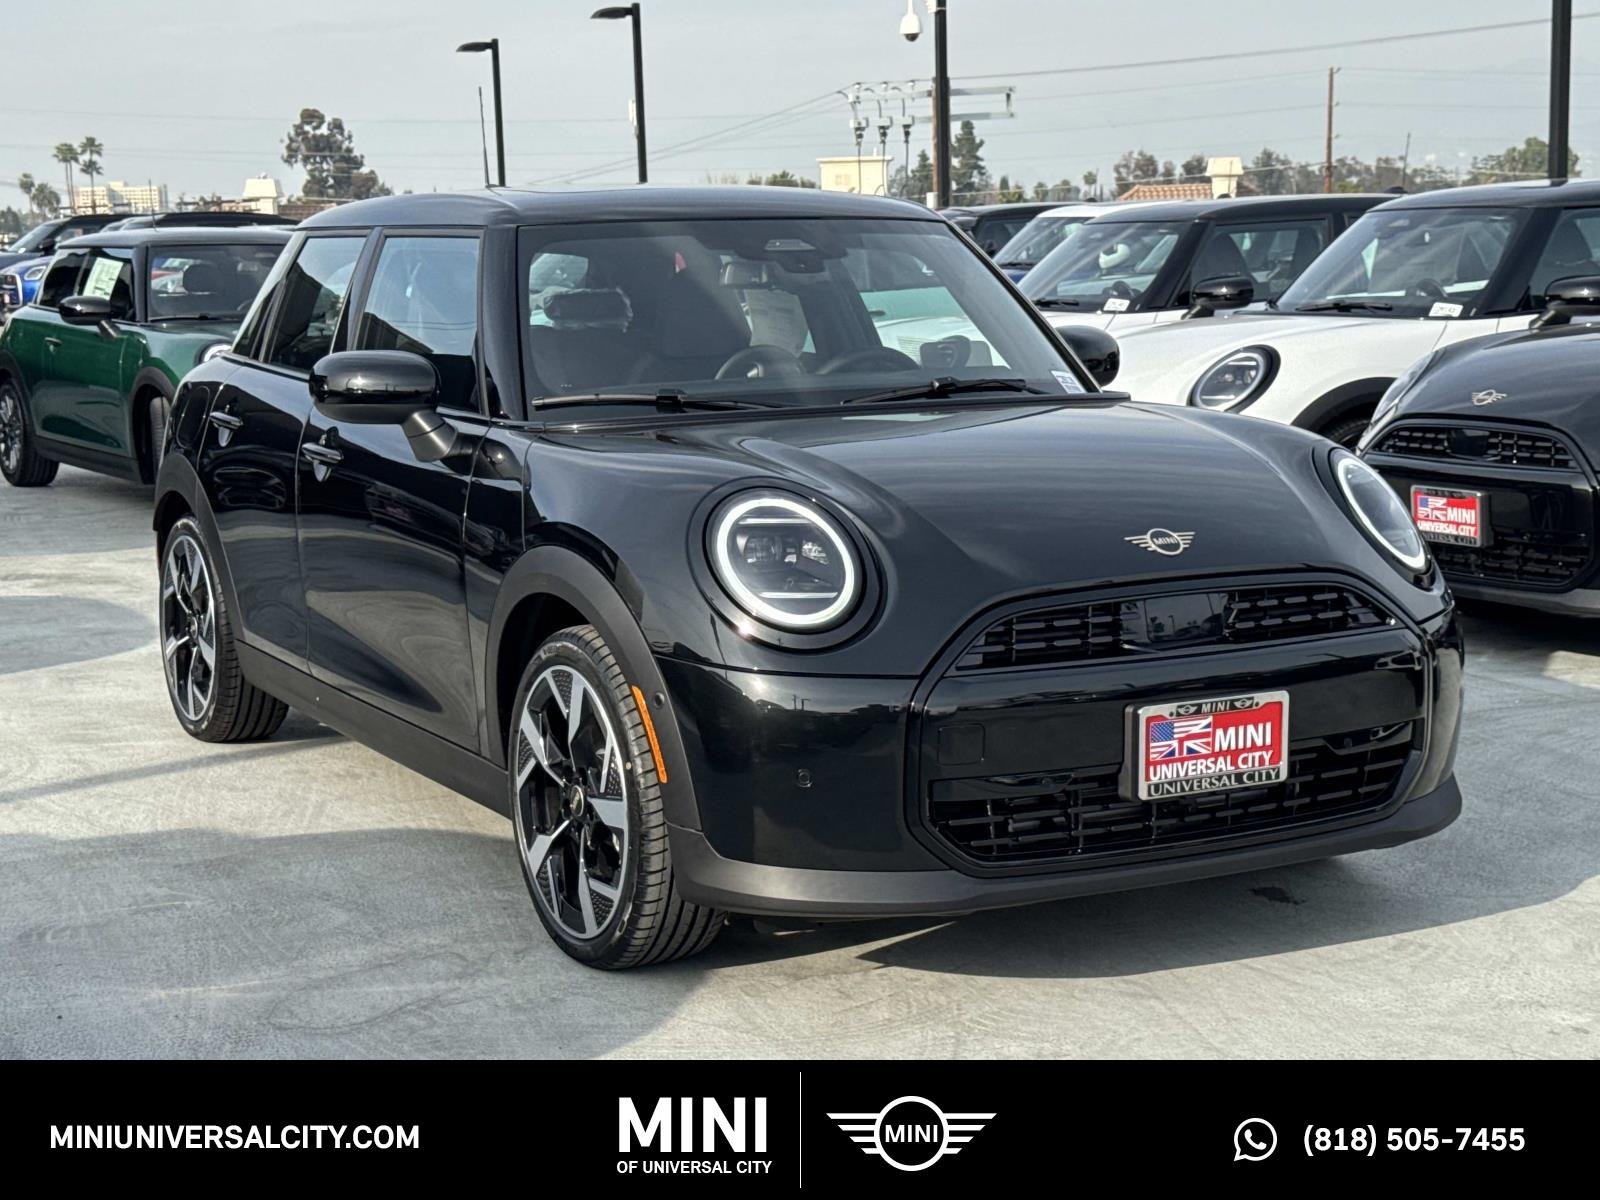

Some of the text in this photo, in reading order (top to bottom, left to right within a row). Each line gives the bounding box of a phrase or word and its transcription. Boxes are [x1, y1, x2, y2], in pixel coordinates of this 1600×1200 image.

[1447, 507, 1476, 524] MINI
[1417, 520, 1476, 537] UNIVERSAL CITY
[1201, 700, 1231, 714] MINI
[1214, 721, 1272, 753] MINI
[1150, 749, 1274, 782] UNIVERSAL CITY
[1150, 767, 1281, 797] UNIVERSAL CITY
